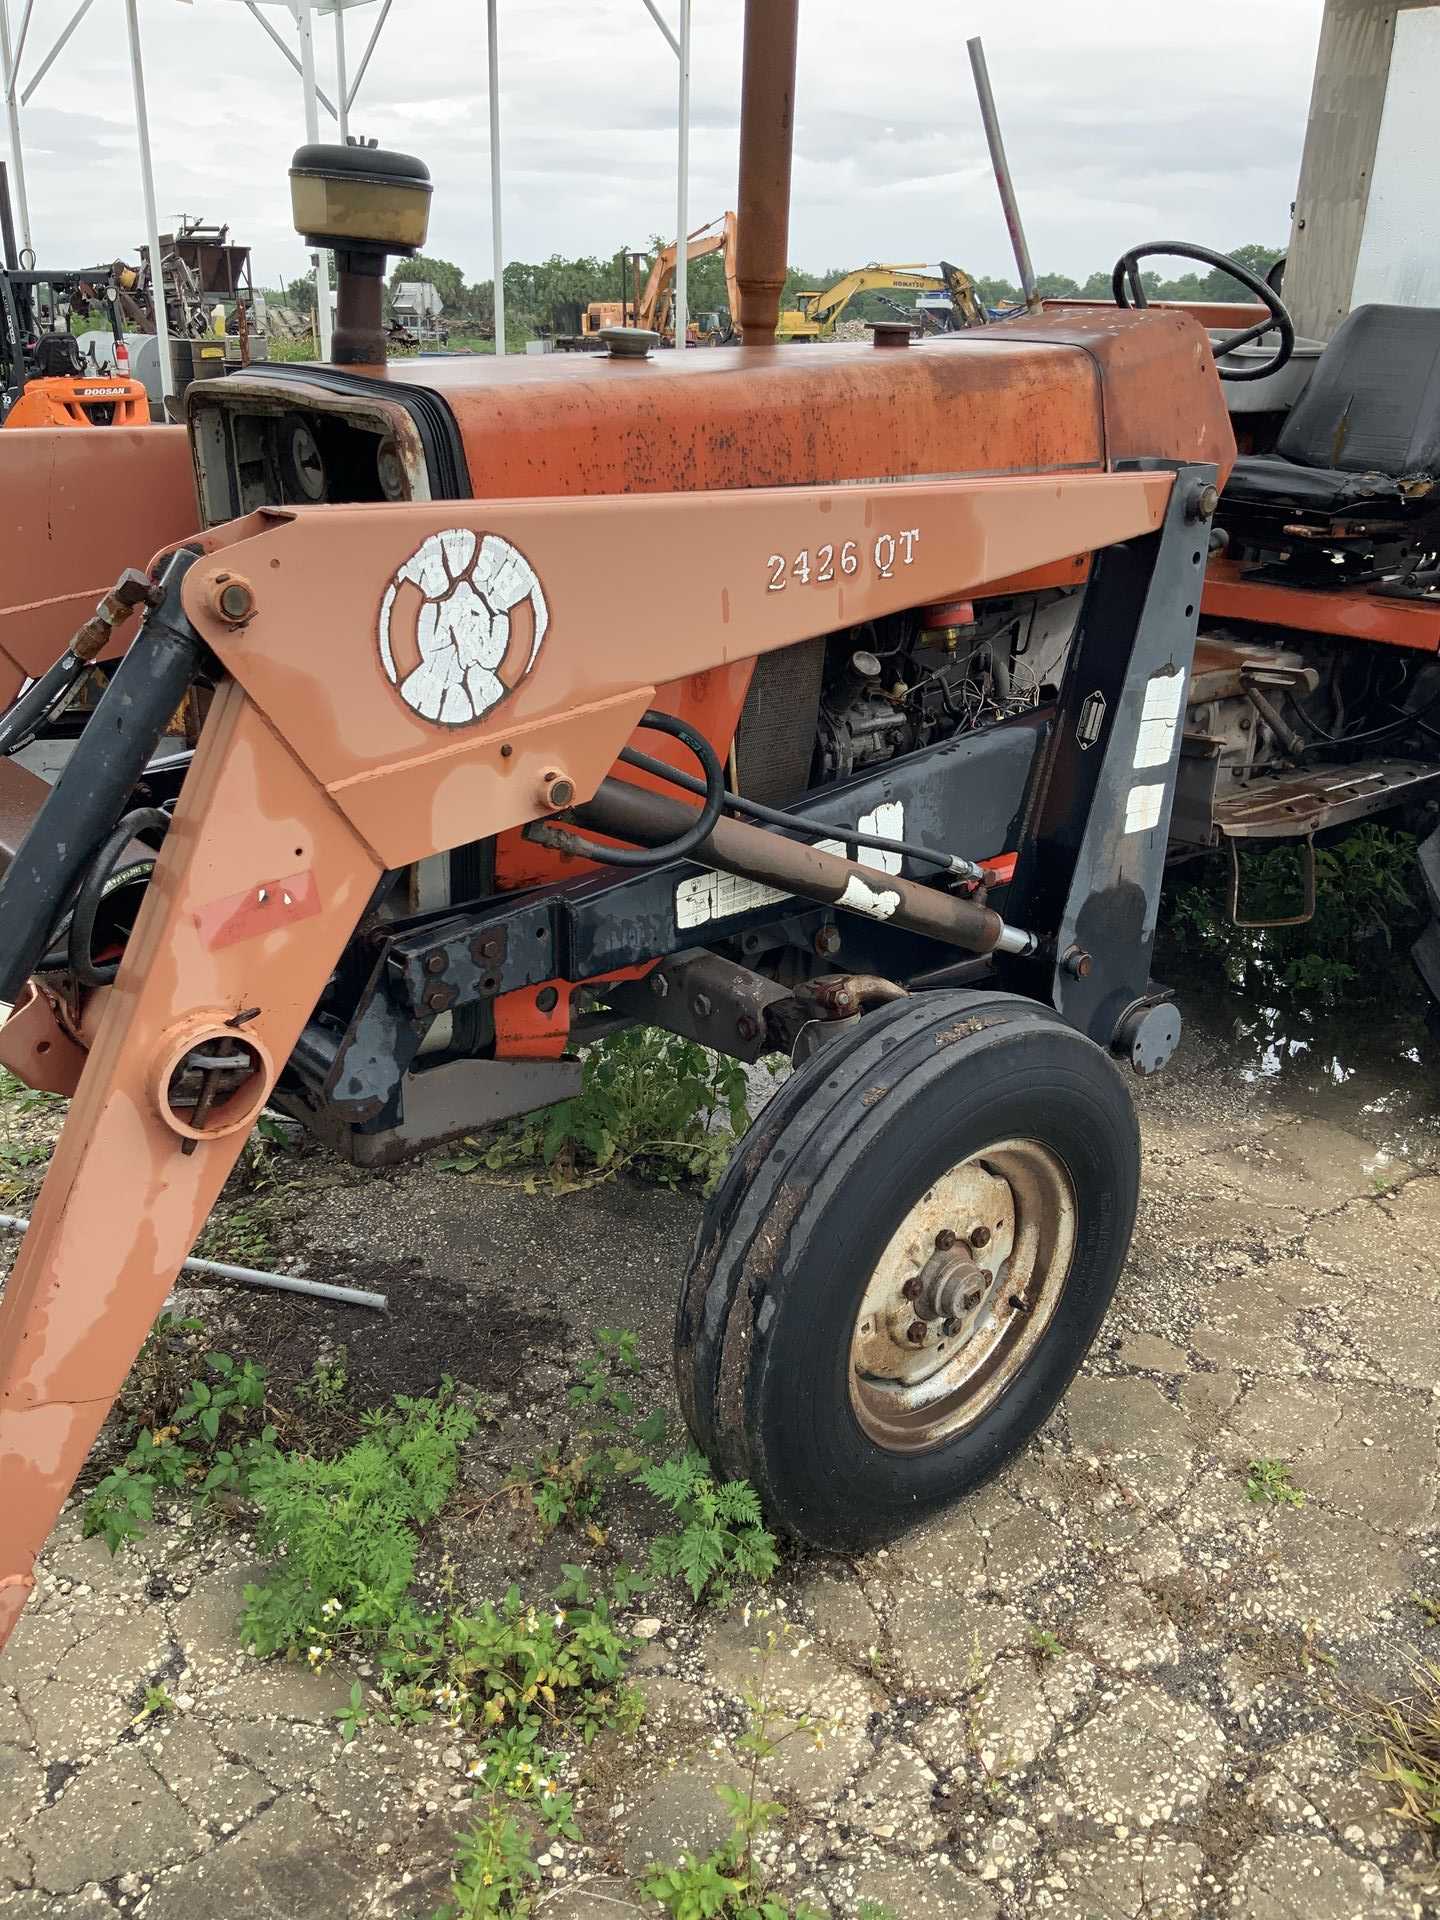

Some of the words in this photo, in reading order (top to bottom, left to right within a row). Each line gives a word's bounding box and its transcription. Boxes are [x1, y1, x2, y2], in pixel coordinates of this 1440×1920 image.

[84, 387, 125, 396] DOOSAN
[766, 540, 858, 591] 2426
[874, 528, 920, 578] QT
